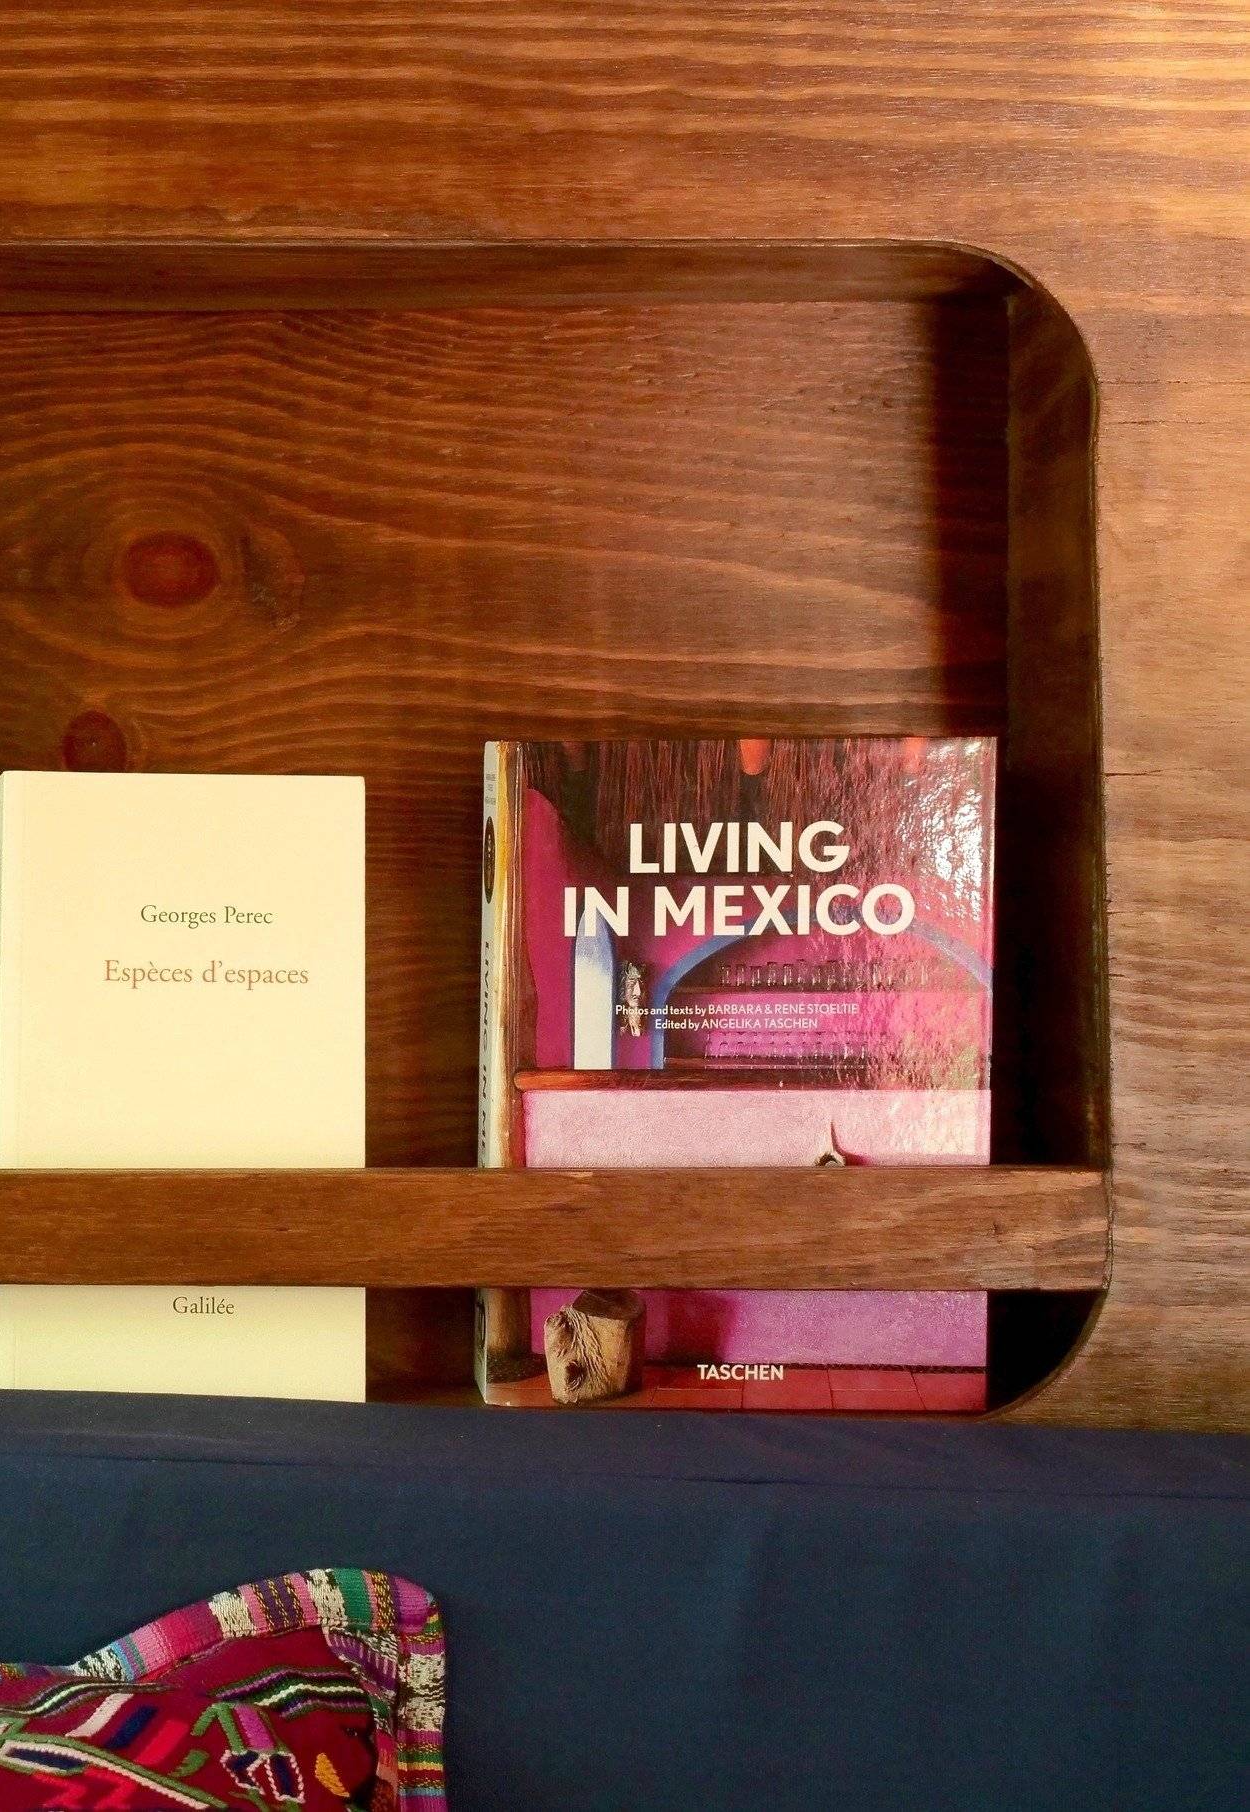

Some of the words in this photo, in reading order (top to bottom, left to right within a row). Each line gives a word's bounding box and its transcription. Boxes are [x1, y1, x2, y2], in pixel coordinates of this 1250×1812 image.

[629, 820, 850, 874] LIVING
[140, 904, 217, 930] Georges
[224, 905, 273, 924] Perec
[564, 886, 629, 937] IN
[654, 883, 916, 937] MEXICO
[104, 959, 193, 989] Espèces
[202, 960, 309, 991] d'espaces
[615, 1004, 649, 1015] Photos
[650, 1004, 668, 1015] and
[670, 1005, 694, 1015] texts
[695, 1004, 707, 1017] by
[708, 1003, 762, 1015] BARBARA
[764, 1003, 773, 1015] &
[807, 1003, 859, 1015] STOELTIE
[655, 1018, 687, 1030] Edited
[688, 1018, 700, 1031] by
[701, 1018, 762, 1029] ANGELIKA
[764, 1018, 818, 1029] TASCHEN
[172, 1296, 235, 1315] Galilée
[697, 1364, 784, 1380] TASCHEN
